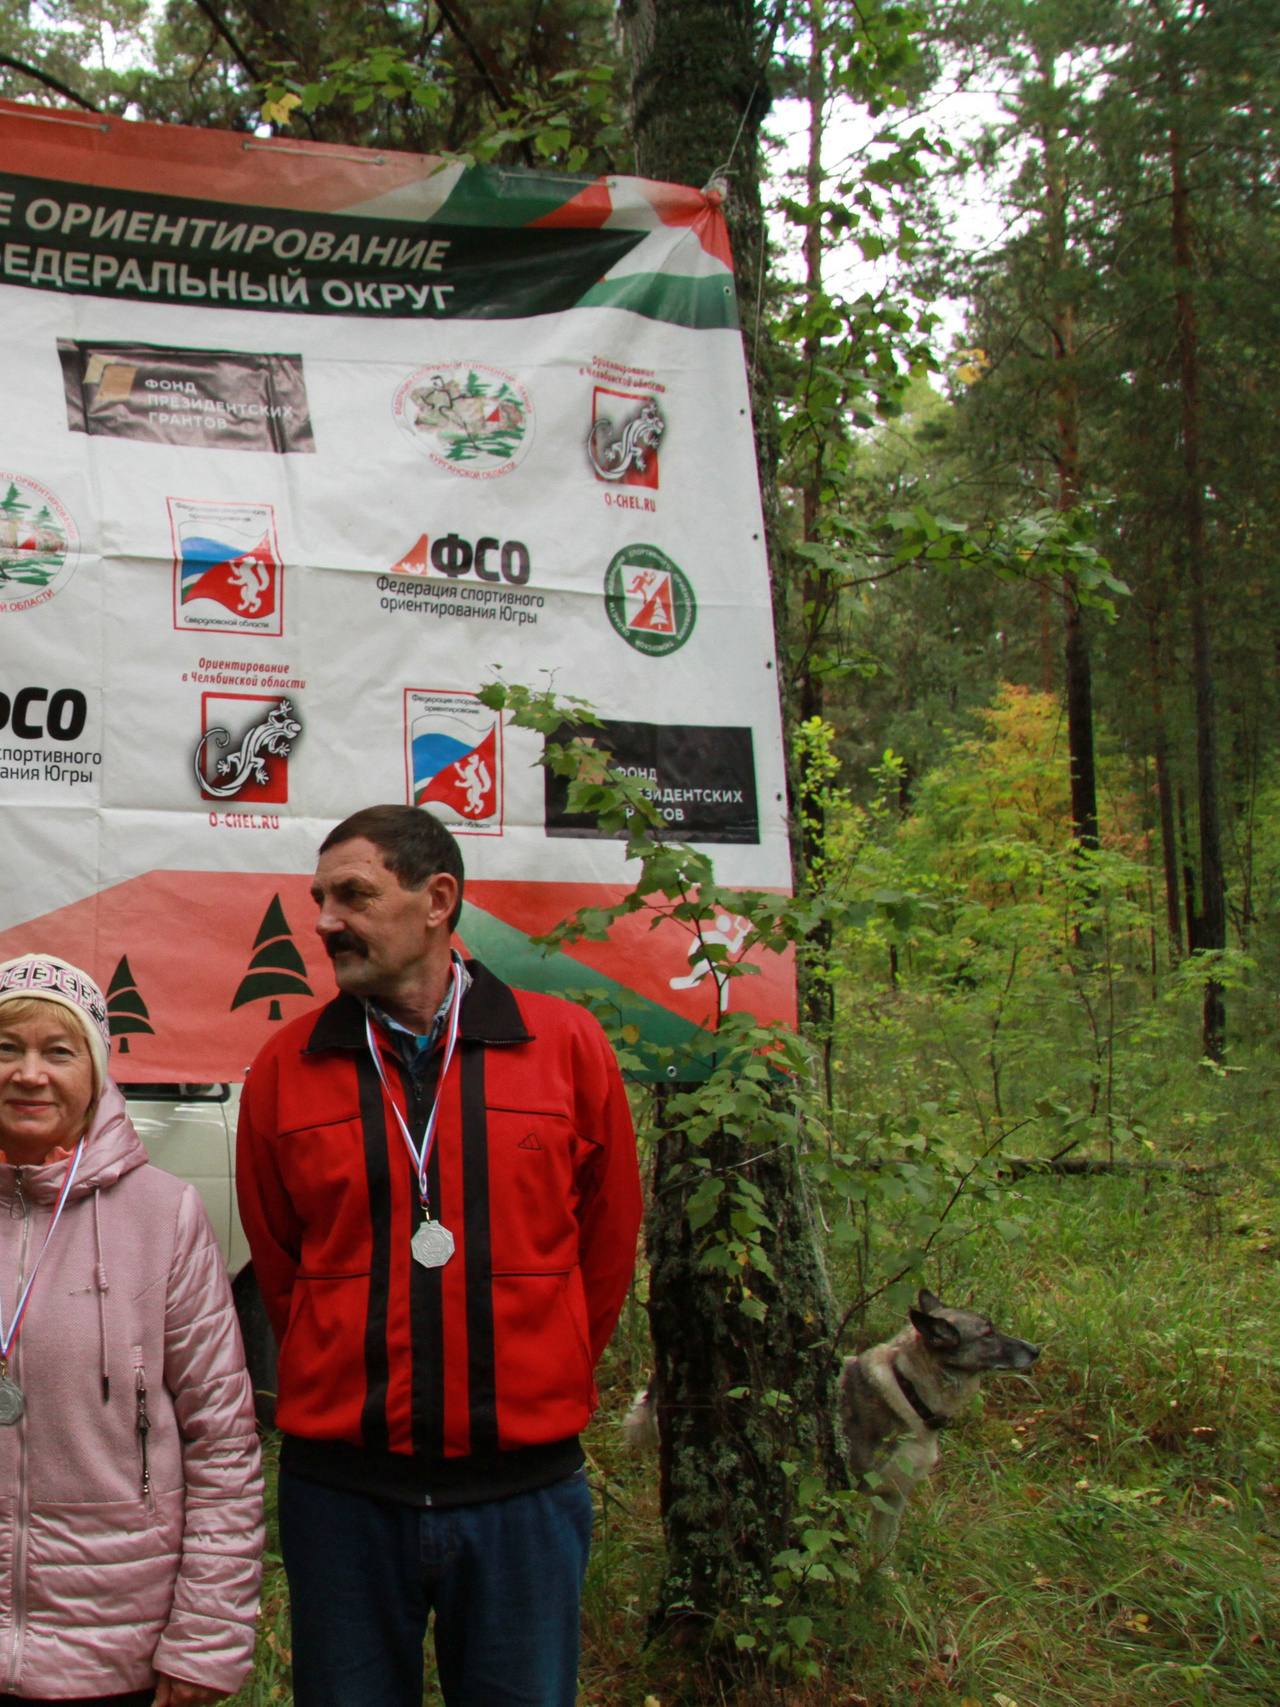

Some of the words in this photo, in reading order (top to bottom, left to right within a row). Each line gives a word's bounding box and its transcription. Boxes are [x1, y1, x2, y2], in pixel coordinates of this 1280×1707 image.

[25, 198, 451, 272] ОРИЕНТИРОВАНИЕ
[322, 279, 454, 310] ОКРУГ
[144, 378, 197, 393] ФОНД
[147, 394, 294, 418] ПРЕЗИДЕНТСКИХ
[148, 412, 228, 429] ГРАНТОВ
[431, 533, 531, 585] ФСО
[10, 589, 55, 612] ОБЛАСТИ
[376, 575, 457, 598] Федерация
[460, 587, 545, 607] спортивного
[380, 597, 496, 619] ориентирования
[499, 606, 538, 626] Югры
[199, 657, 290, 674] Ориентирование
[182, 673, 188, 682] в
[191, 672, 258, 687] Челябинской
[261, 676, 306, 689] области
[45, 765, 93, 786] Югры
[638, 788, 743, 803] ЗИДЕНТСКИХ
